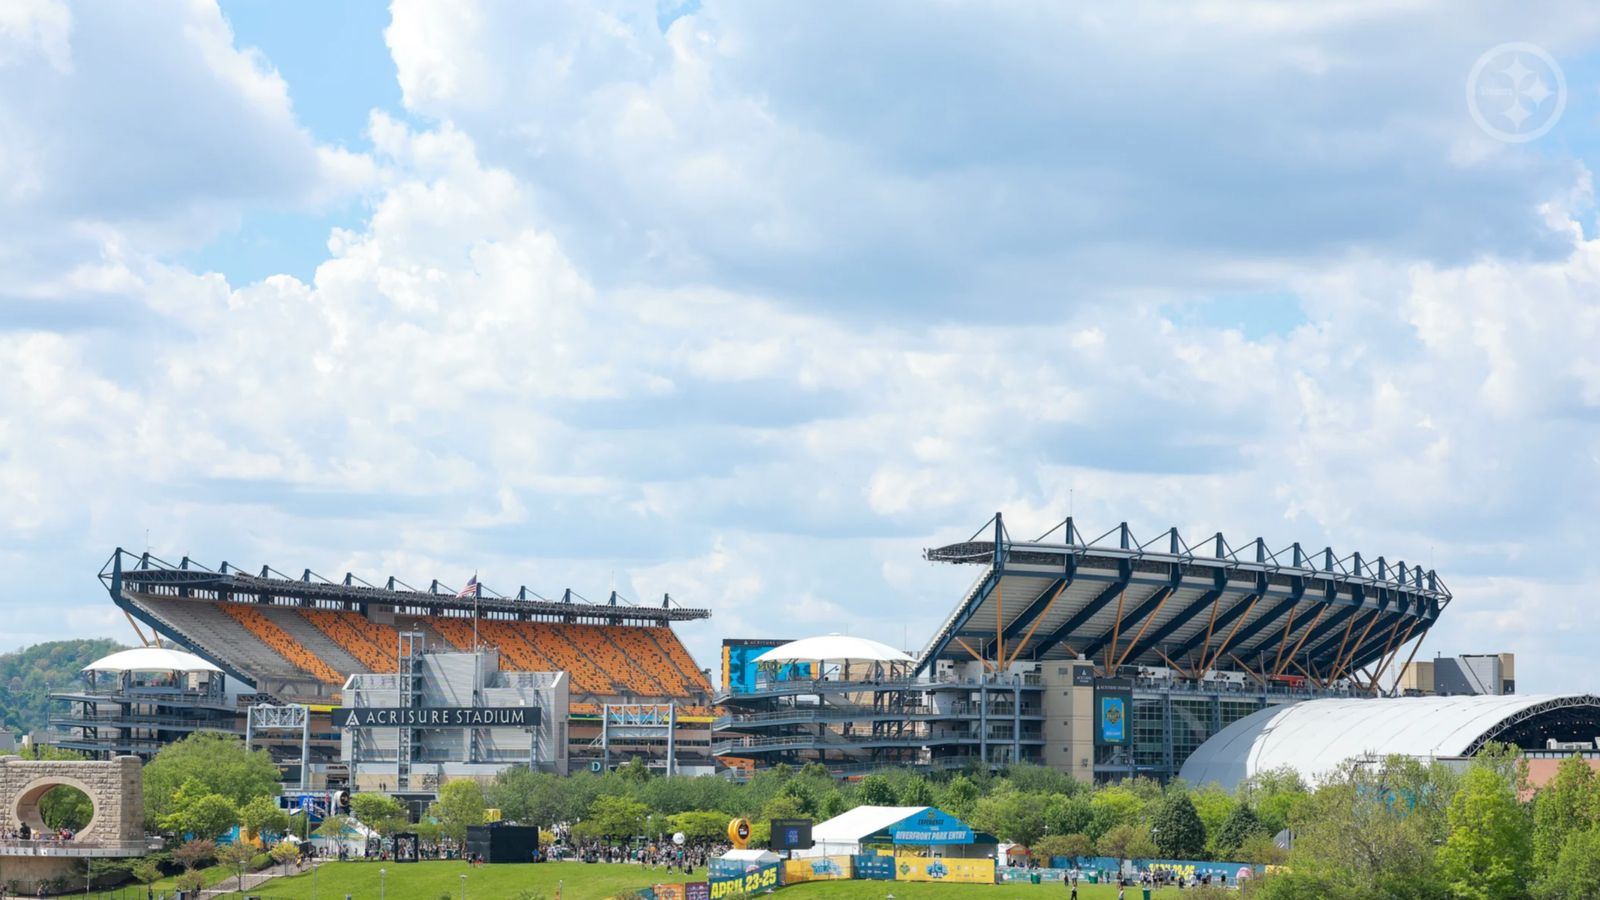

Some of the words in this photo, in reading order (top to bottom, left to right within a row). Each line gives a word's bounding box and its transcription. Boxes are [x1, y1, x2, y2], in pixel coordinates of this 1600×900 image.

[366, 710, 449, 724] ACRISURE
[456, 709, 524, 723] STADIUM
[591, 761, 601, 771] D
[895, 831, 932, 840] RIVERFRONT
[931, 831, 949, 840] PARK
[948, 831, 967, 840] ENTRY
[710, 878, 744, 899] APRIL
[745, 866, 777, 892] 23-25
